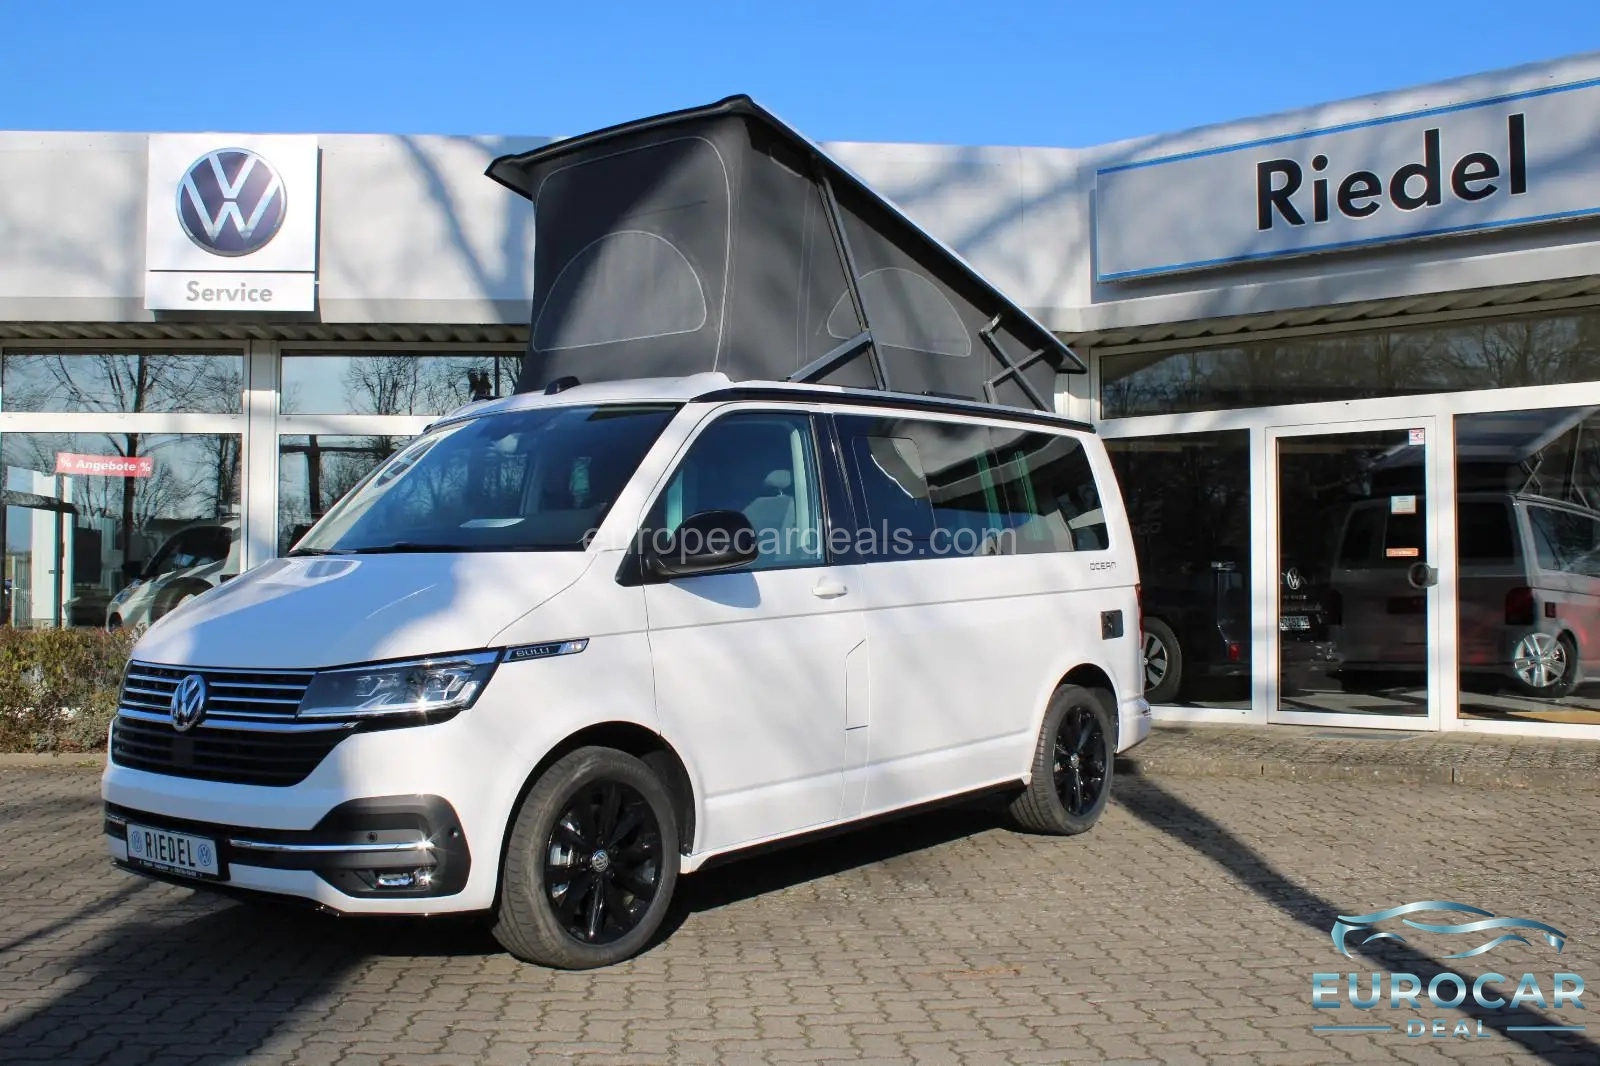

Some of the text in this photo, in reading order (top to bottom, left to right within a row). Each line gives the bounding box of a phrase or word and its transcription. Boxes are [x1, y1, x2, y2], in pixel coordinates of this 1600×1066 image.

[1257, 112, 1526, 231] Riedel
[186, 281, 273, 302] Service
[76, 460, 137, 472] Angebote
[1090, 561, 1117, 571] OCEAN
[516, 647, 550, 657] BULLI
[144, 831, 196, 867] RIEDEL
